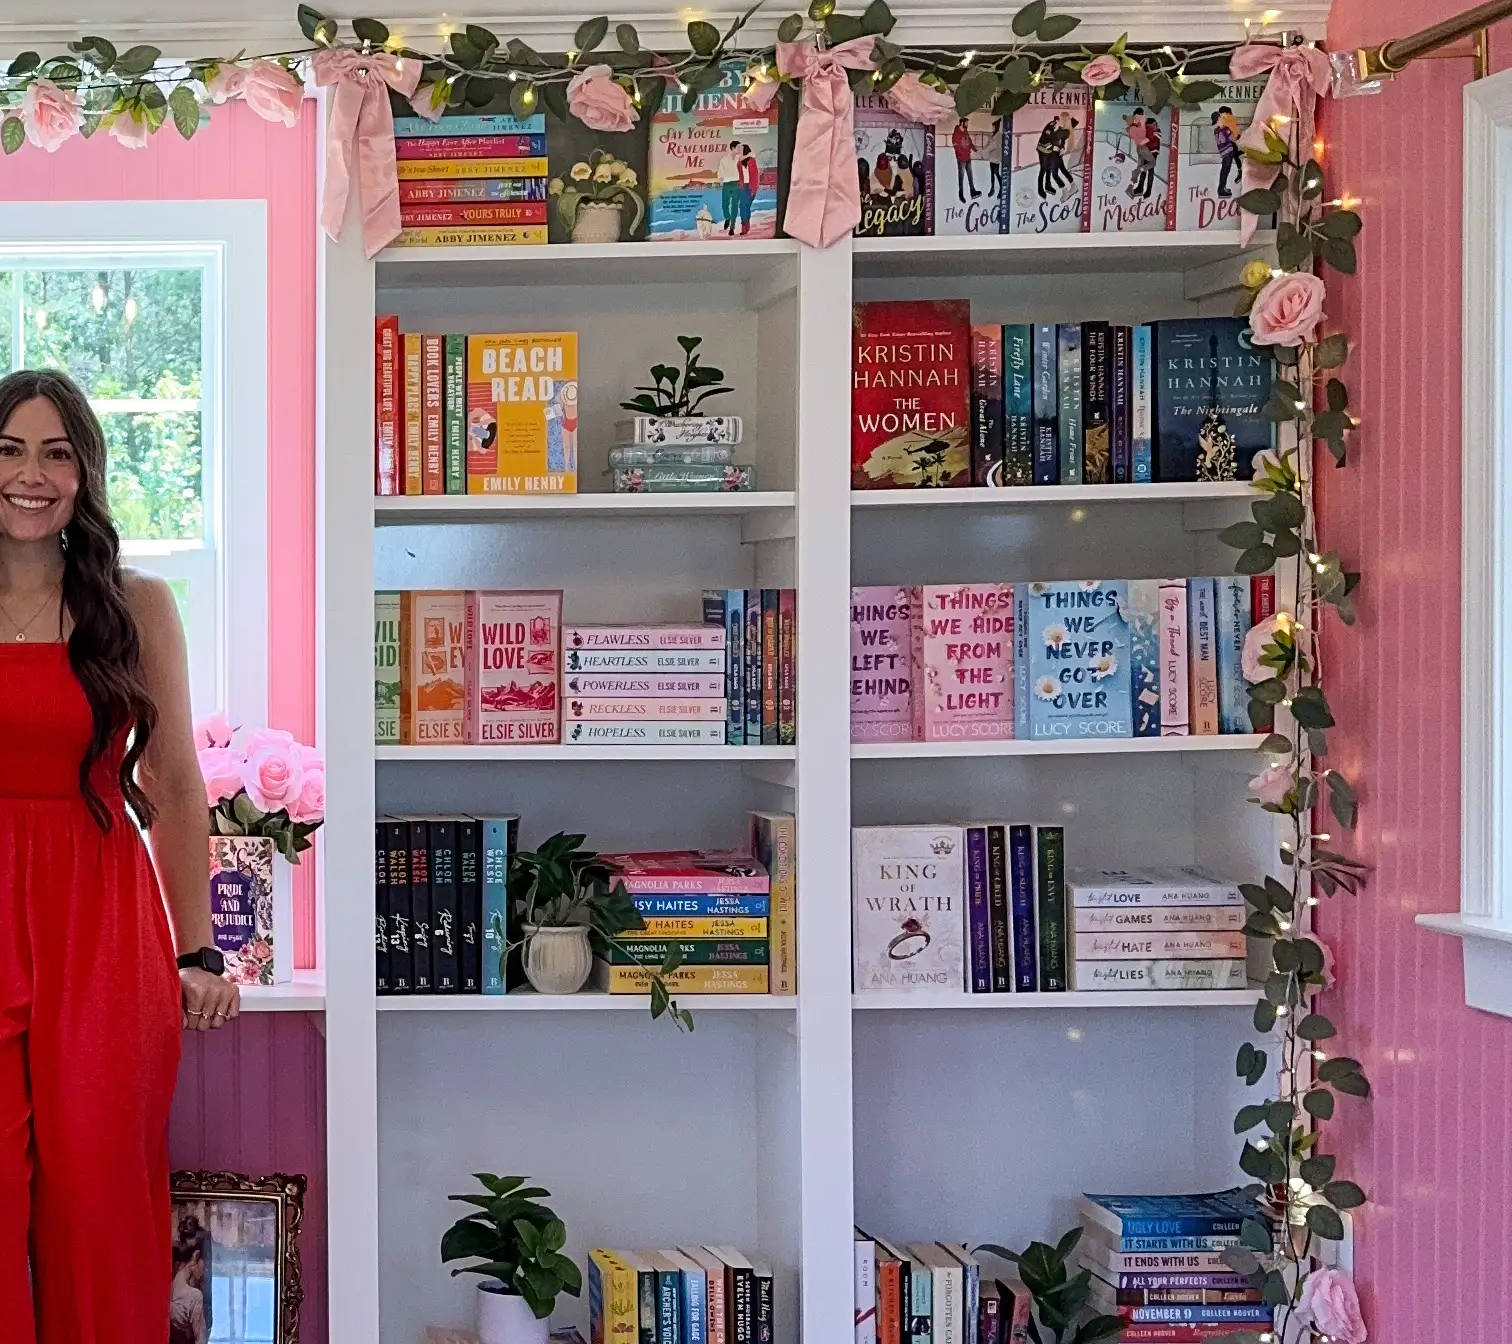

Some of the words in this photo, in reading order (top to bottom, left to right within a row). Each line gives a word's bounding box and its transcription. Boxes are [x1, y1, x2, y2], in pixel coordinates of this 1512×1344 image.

[666, 141, 728, 158] REMEMBER
[685, 155, 704, 169] ME
[1097, 193, 1118, 211] The
[463, 208, 495, 220] YOURS
[495, 207, 522, 218] TRULY
[855, 194, 924, 235] Legacy
[434, 234, 464, 243] ABBY
[466, 233, 517, 243] JIMENEZ
[482, 347, 563, 374] BEACH
[858, 343, 954, 364] KRISTIN
[1011, 336, 1025, 371] Firefly
[1167, 356, 1262, 371] KRISTIN
[854, 368, 959, 388] HANNAH
[1167, 374, 1262, 389] HANNAH
[491, 377, 555, 403] READ
[892, 397, 921, 410] THE
[978, 399, 987, 422] Great
[1195, 403, 1259, 417] Nightingale
[858, 411, 956, 433] WOMEN
[483, 477, 522, 492] EMILY
[524, 475, 565, 491] HENRY
[935, 592, 1010, 610] THINGS
[1040, 589, 1118, 608] THINGS
[481, 622, 526, 645] WILD
[931, 619, 962, 636] WE
[972, 617, 1015, 635] HIDE
[1063, 616, 1095, 634] WE
[586, 634, 650, 645] FLAWLESS
[860, 629, 890, 646] WE
[483, 647, 525, 669] LOVE
[944, 642, 1001, 660] FROM
[1046, 640, 1114, 660] NEVER
[852, 653, 899, 672] LEFT
[955, 667, 994, 685] THE
[1168, 660, 1177, 684] LUCY
[946, 692, 1004, 711] LIGHT
[1052, 691, 1108, 709] OVER
[1168, 687, 1178, 717] SCORE
[418, 722, 450, 739] ELSIE
[483, 722, 515, 739] ELSIE
[517, 722, 555, 739] SILVER
[1034, 722, 1072, 737] LUCY
[1079, 719, 1128, 736] SCORE
[443, 849, 452, 884] CHLOE
[486, 849, 494, 884] WALSH
[494, 849, 503, 884] CHLOE
[879, 864, 937, 880] KING
[217, 882, 244, 898] PRIDE
[900, 883, 916, 893] OF
[220, 899, 241, 913] AND
[656, 900, 699, 911] HAITES
[715, 897, 740, 906] JESSA
[865, 896, 952, 912] WRATH
[1113, 893, 1141, 903] LOVE
[706, 906, 750, 915] HASTINGS
[1116, 914, 1153, 924] GAMES
[655, 920, 694, 929] HAITES
[390, 933, 400, 945] 13
[484, 928, 494, 939] 10
[1121, 942, 1152, 953] HATE
[1119, 969, 1144, 979] LIES
[1128, 1221, 1153, 1233] UGLY
[1155, 1221, 1182, 1233] LOVE
[1136, 1238, 1167, 1249] STARTS
[1169, 1238, 1194, 1249] WITH
[1195, 1238, 1208, 1249] US
[1124, 1257, 1134, 1267] IT
[1135, 1256, 1159, 1267] ENDS
[1161, 1256, 1186, 1267] WITH
[1186, 1256, 1200, 1266] US
[1169, 1276, 1208, 1286] PERFECTS
[736, 1275, 745, 1311] EVELYN
[944, 1278, 953, 1328] FORGOTTEN
[1131, 1309, 1182, 1320] NOVEMBER
[1201, 1309, 1232, 1317] COLLEEN
[736, 1313, 745, 1342] HUGO
